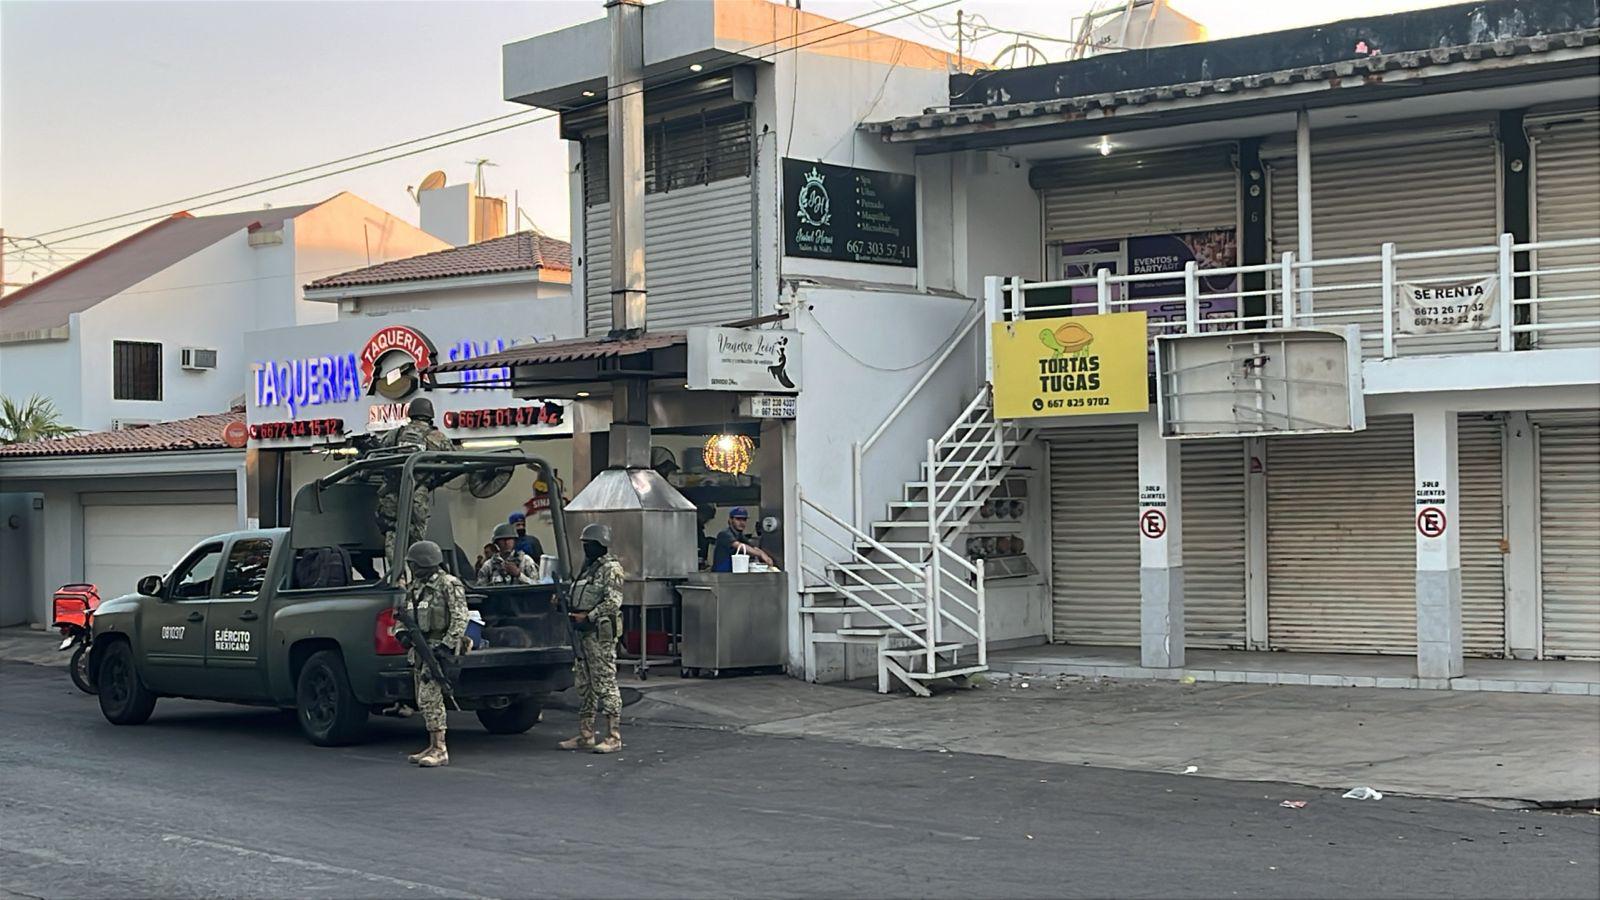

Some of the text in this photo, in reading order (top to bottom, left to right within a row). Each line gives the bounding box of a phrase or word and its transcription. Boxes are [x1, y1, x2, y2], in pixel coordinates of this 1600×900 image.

[847, 240, 864, 254] 667
[867, 242, 884, 255] 303
[886, 244, 898, 256] 57
[900, 246, 910, 259] 41
[1134, 256, 1172, 266] EVENTOS
[1134, 263, 1178, 274] PARTYART
[1414, 286, 1484, 300] SE RENTA
[1414, 307, 1438, 315] 6673
[1442, 306, 1454, 314] 26
[1457, 304, 1468, 313] 77
[1414, 317, 1438, 326] 6671
[1442, 317, 1454, 325] 22
[365, 330, 424, 363] TAQUERIA
[718, 333, 753, 353] Vanessa
[1039, 356, 1099, 374] TORTAS
[250, 352, 361, 419] TAQUERIA
[1040, 373, 1100, 393] TUGAS
[1048, 399, 1063, 408] 667
[1067, 398, 1084, 407] 825
[459, 410, 490, 428] 6675
[496, 409, 511, 427] 01
[515, 407, 532, 424] 47
[261, 423, 287, 439] 6672
[291, 421, 305, 437] 44
[309, 421, 321, 435] 15
[324, 419, 337, 434] 12
[215, 628, 250, 642] EJÉRCITO
[215, 642, 250, 652] MEXICANO
